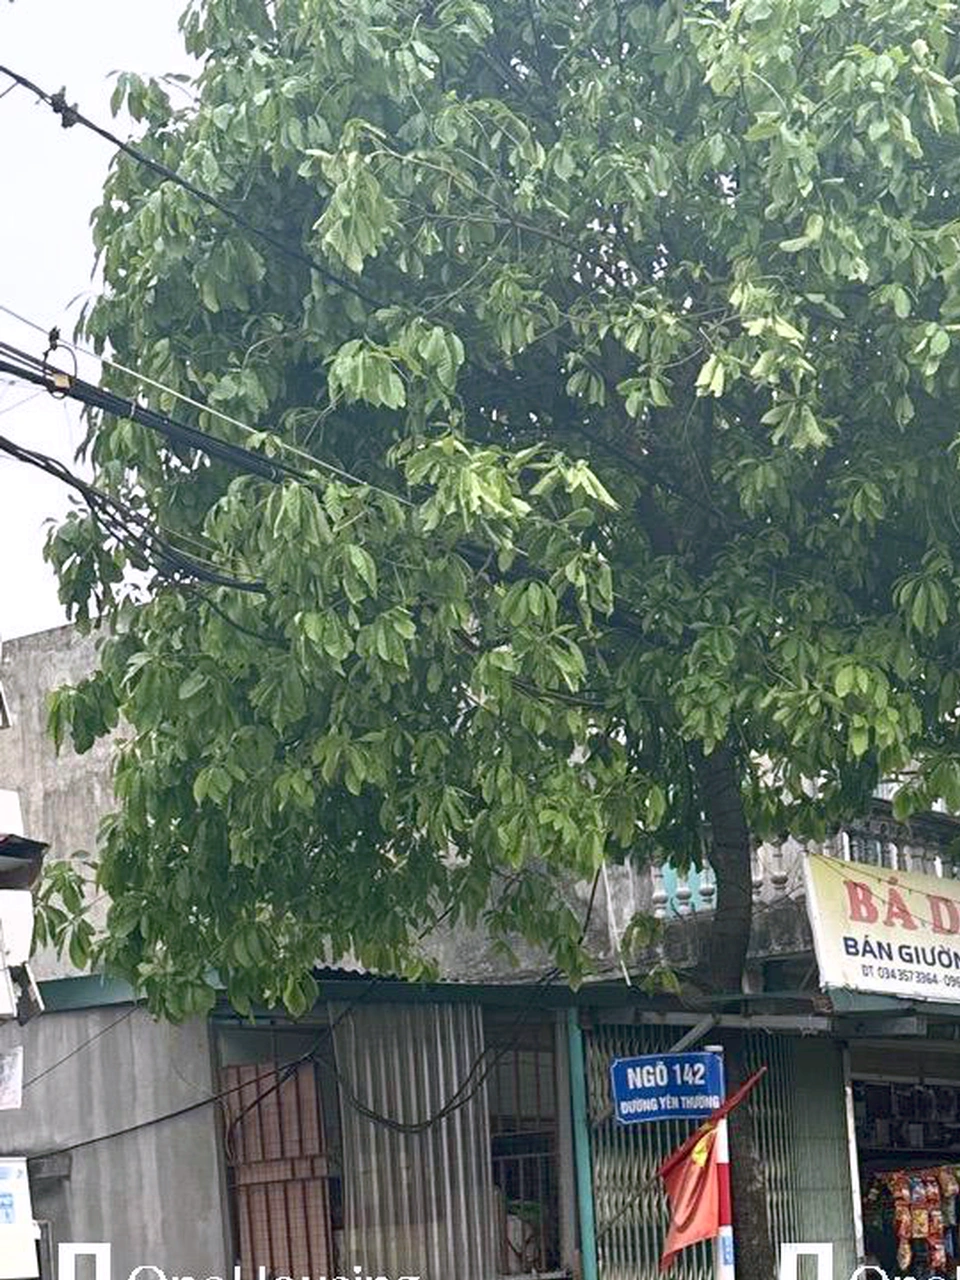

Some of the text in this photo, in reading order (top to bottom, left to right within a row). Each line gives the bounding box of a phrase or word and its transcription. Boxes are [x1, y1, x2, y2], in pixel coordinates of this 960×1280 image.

[842, 935, 893, 962] BÁN
[626, 1061, 706, 1090] NGÕ 142
